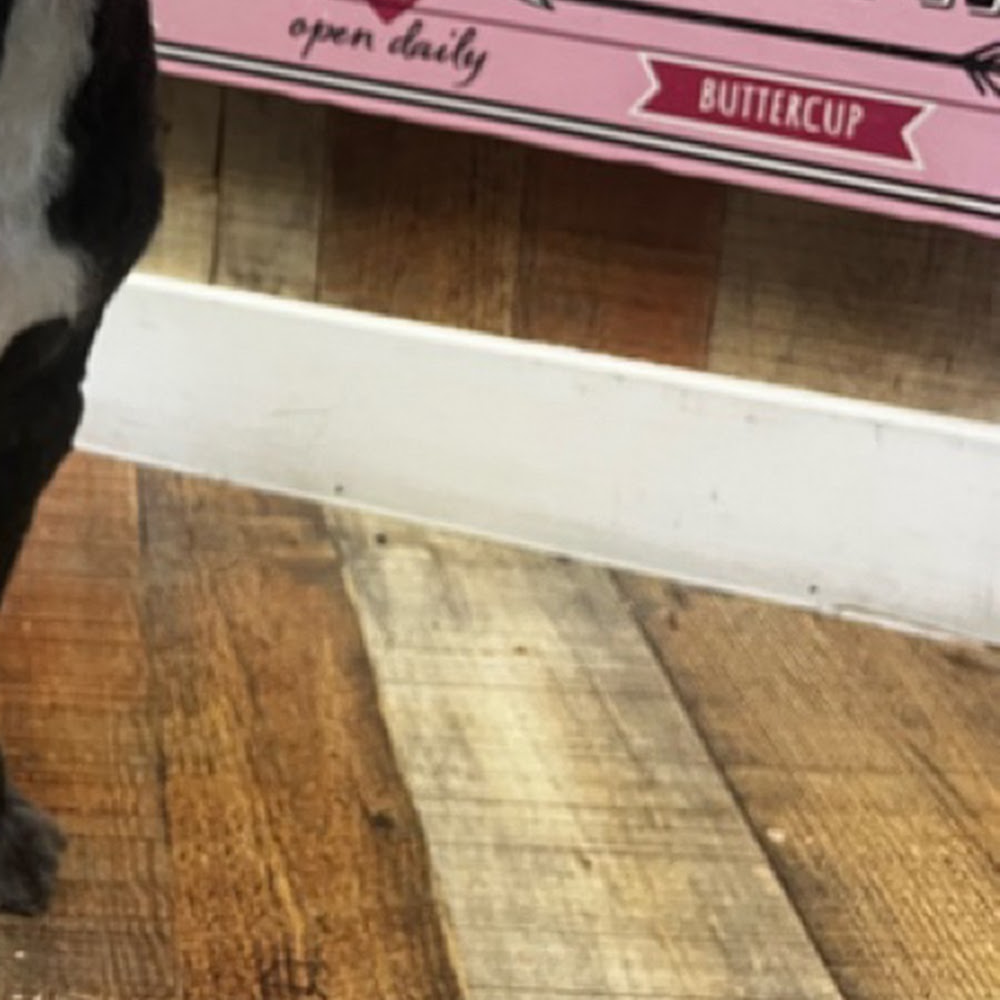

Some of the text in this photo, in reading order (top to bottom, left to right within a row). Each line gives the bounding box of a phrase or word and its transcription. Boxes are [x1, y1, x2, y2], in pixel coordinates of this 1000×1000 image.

[289, 17, 487, 87] open daily
[699, 77, 865, 139] BUTTERCUP
